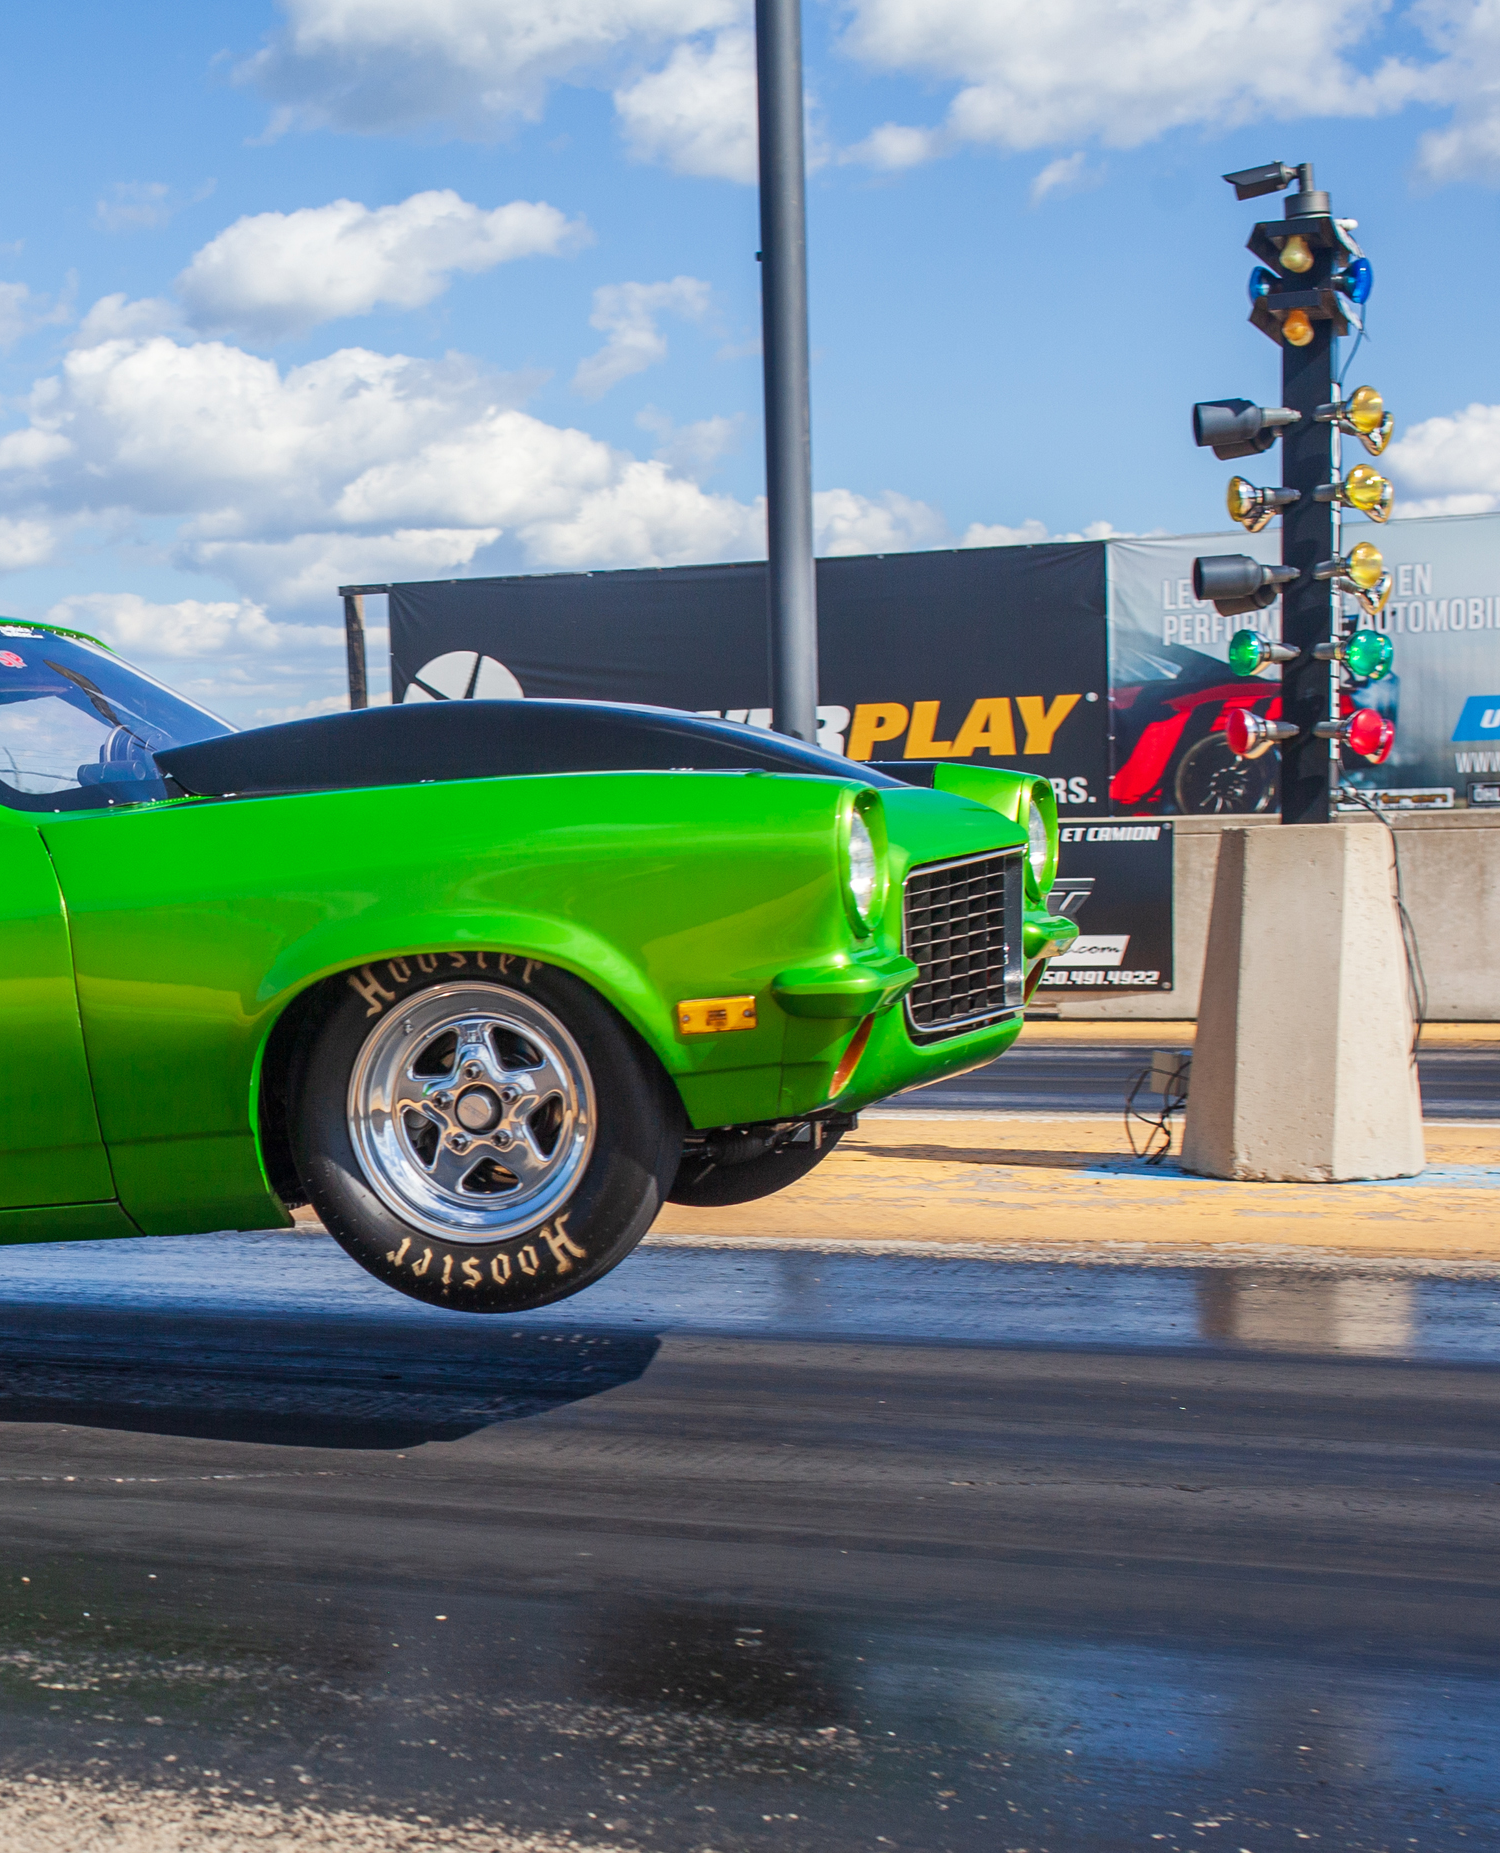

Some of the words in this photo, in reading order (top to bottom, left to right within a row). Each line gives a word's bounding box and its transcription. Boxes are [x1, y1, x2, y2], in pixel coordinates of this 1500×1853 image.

[1163, 579, 1203, 609] LE
[1396, 564, 1432, 596] EN
[1060, 828, 1087, 842] ET
[1086, 826, 1161, 841] CAMION
[386, 1211, 588, 1297] Hoosier
